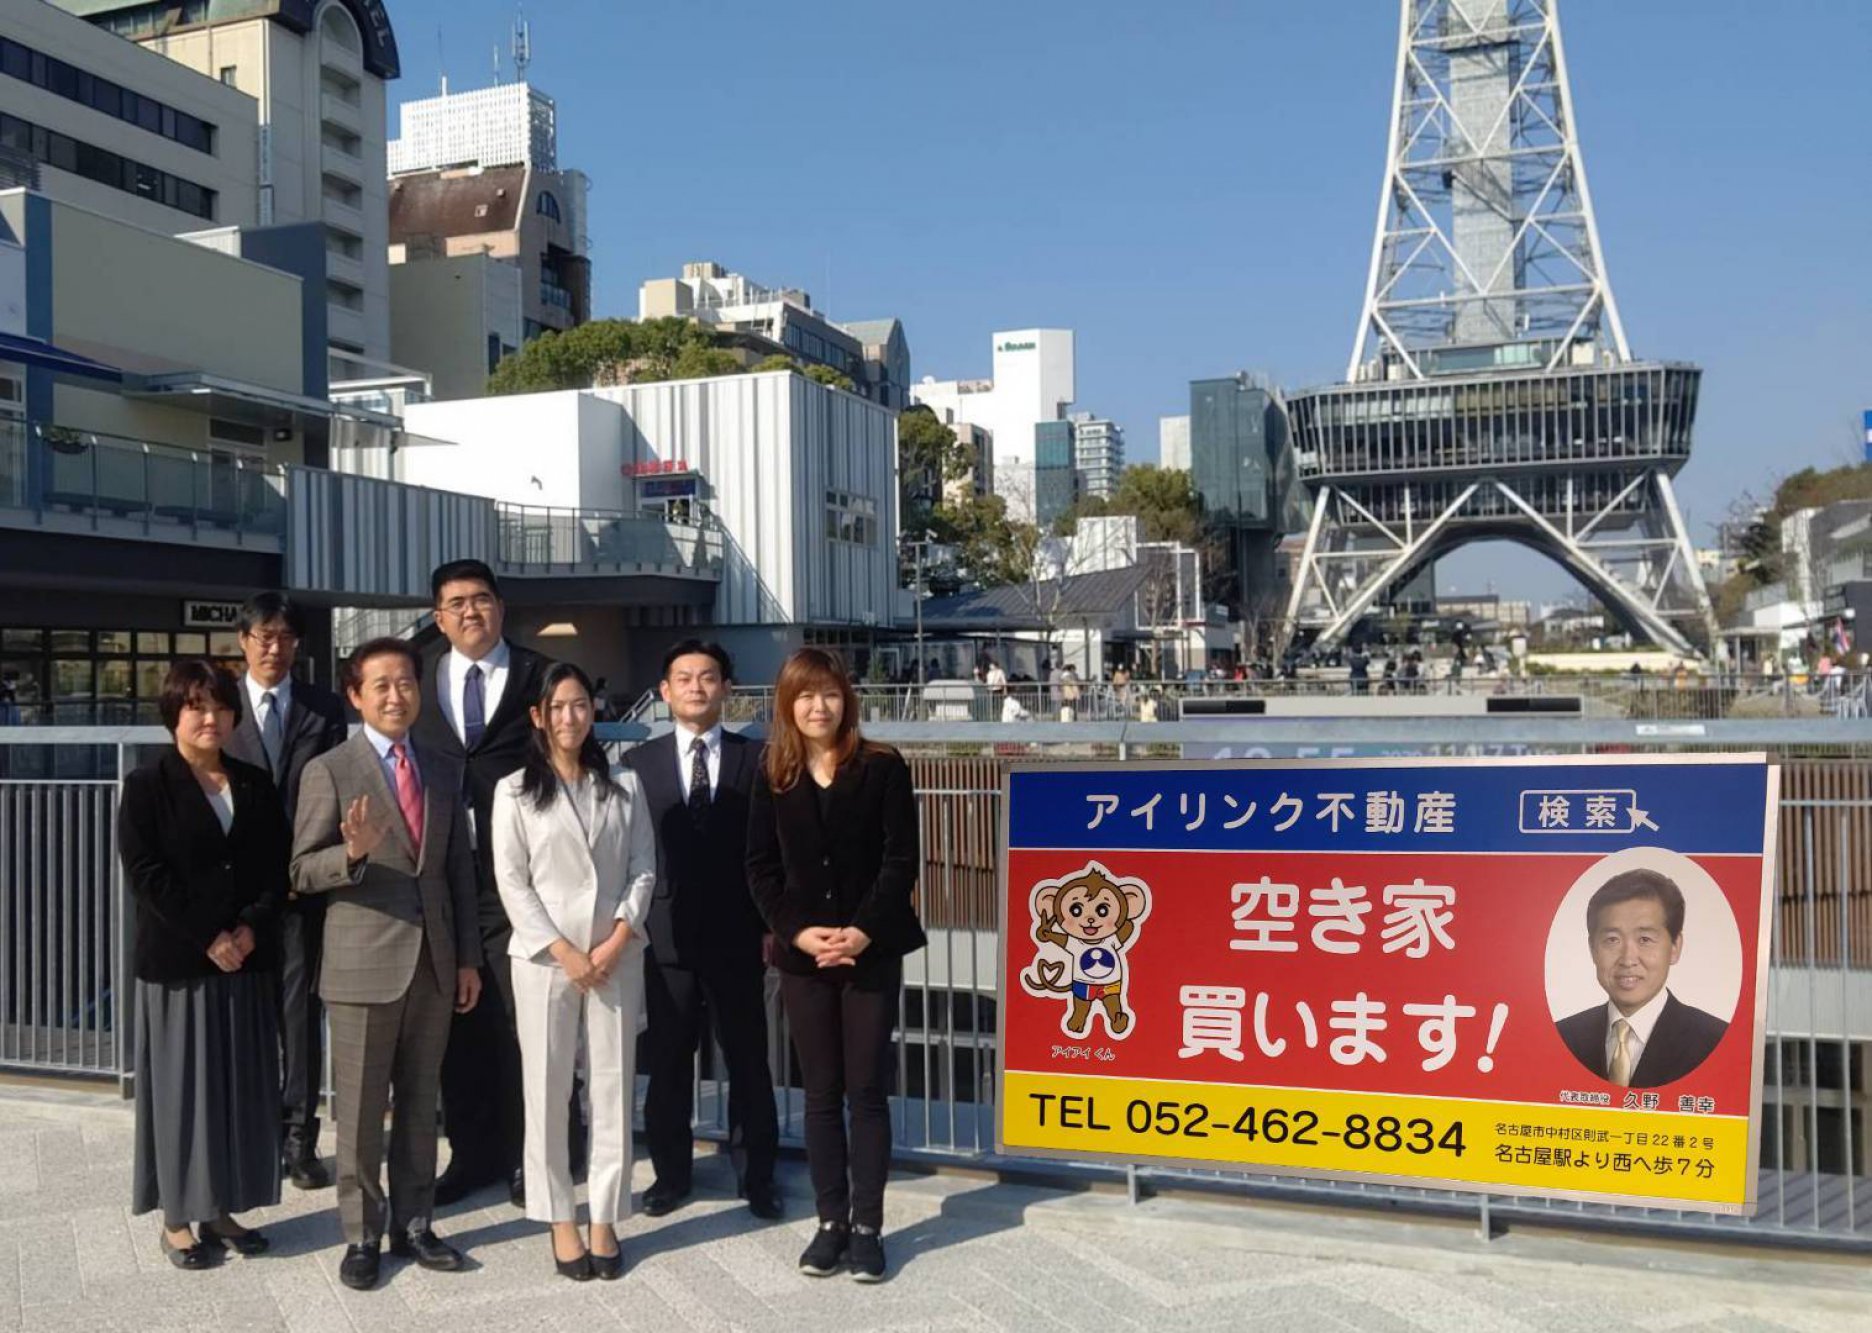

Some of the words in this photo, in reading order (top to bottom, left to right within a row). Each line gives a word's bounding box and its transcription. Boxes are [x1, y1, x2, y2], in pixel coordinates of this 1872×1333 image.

[1085, 790, 1456, 834] アイリンク不動産
[1538, 795, 1616, 828] 検索
[1229, 876, 1456, 958] 空き家
[1178, 984, 1509, 1073] 買います!
[1029, 1093, 1110, 1131] TEL
[1126, 1099, 1467, 1157] 052-462-8834
[1623, 1092, 1659, 1111] 久野
[1678, 1095, 1715, 1114] 善幸
